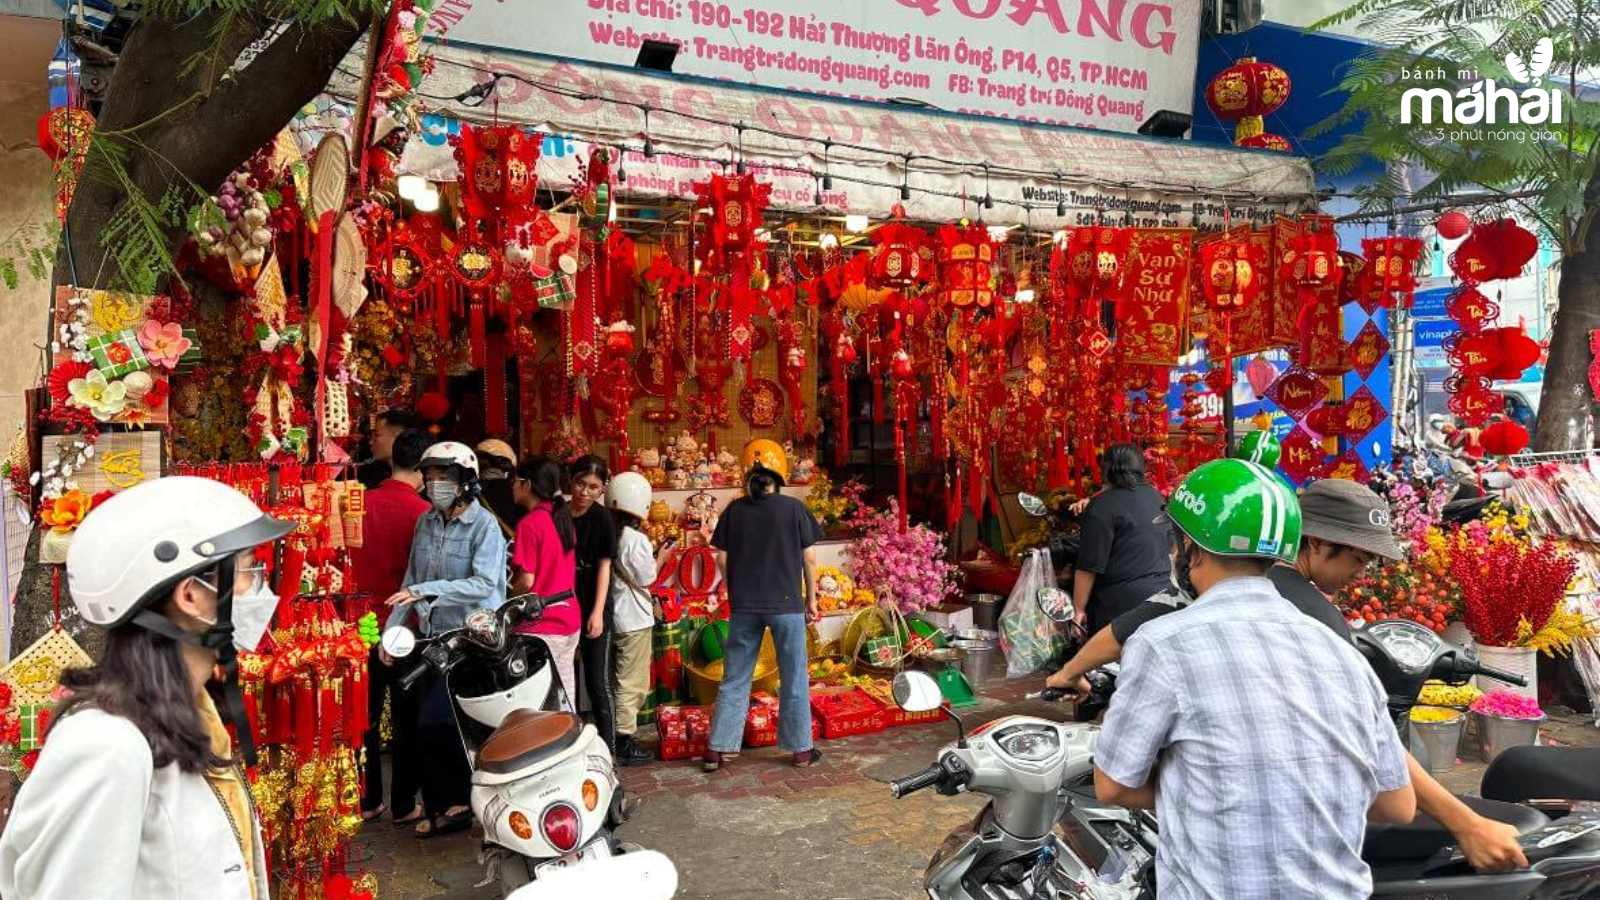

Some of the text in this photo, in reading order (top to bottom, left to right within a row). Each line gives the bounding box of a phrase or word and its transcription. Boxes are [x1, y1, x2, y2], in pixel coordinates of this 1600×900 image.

[688, 1, 784, 37] 190-192
[789, 14, 826, 44] Hải
[831, 22, 911, 63] Thượng
[954, 36, 997, 74] Ông,
[1002, 49, 1042, 79] P14,
[1046, 56, 1075, 84] Q5,
[1079, 61, 1148, 91] TP.HCM
[893, 0, 1177, 55] ANG
[693, 37, 930, 90] Trangtridongquang.com
[948, 73, 974, 94] FB:
[977, 77, 1027, 107] Trang
[1030, 83, 1052, 105] trí
[1054, 88, 1095, 116] Đông
[1097, 95, 1145, 123] Quang
[1174, 484, 1207, 516] Grab
